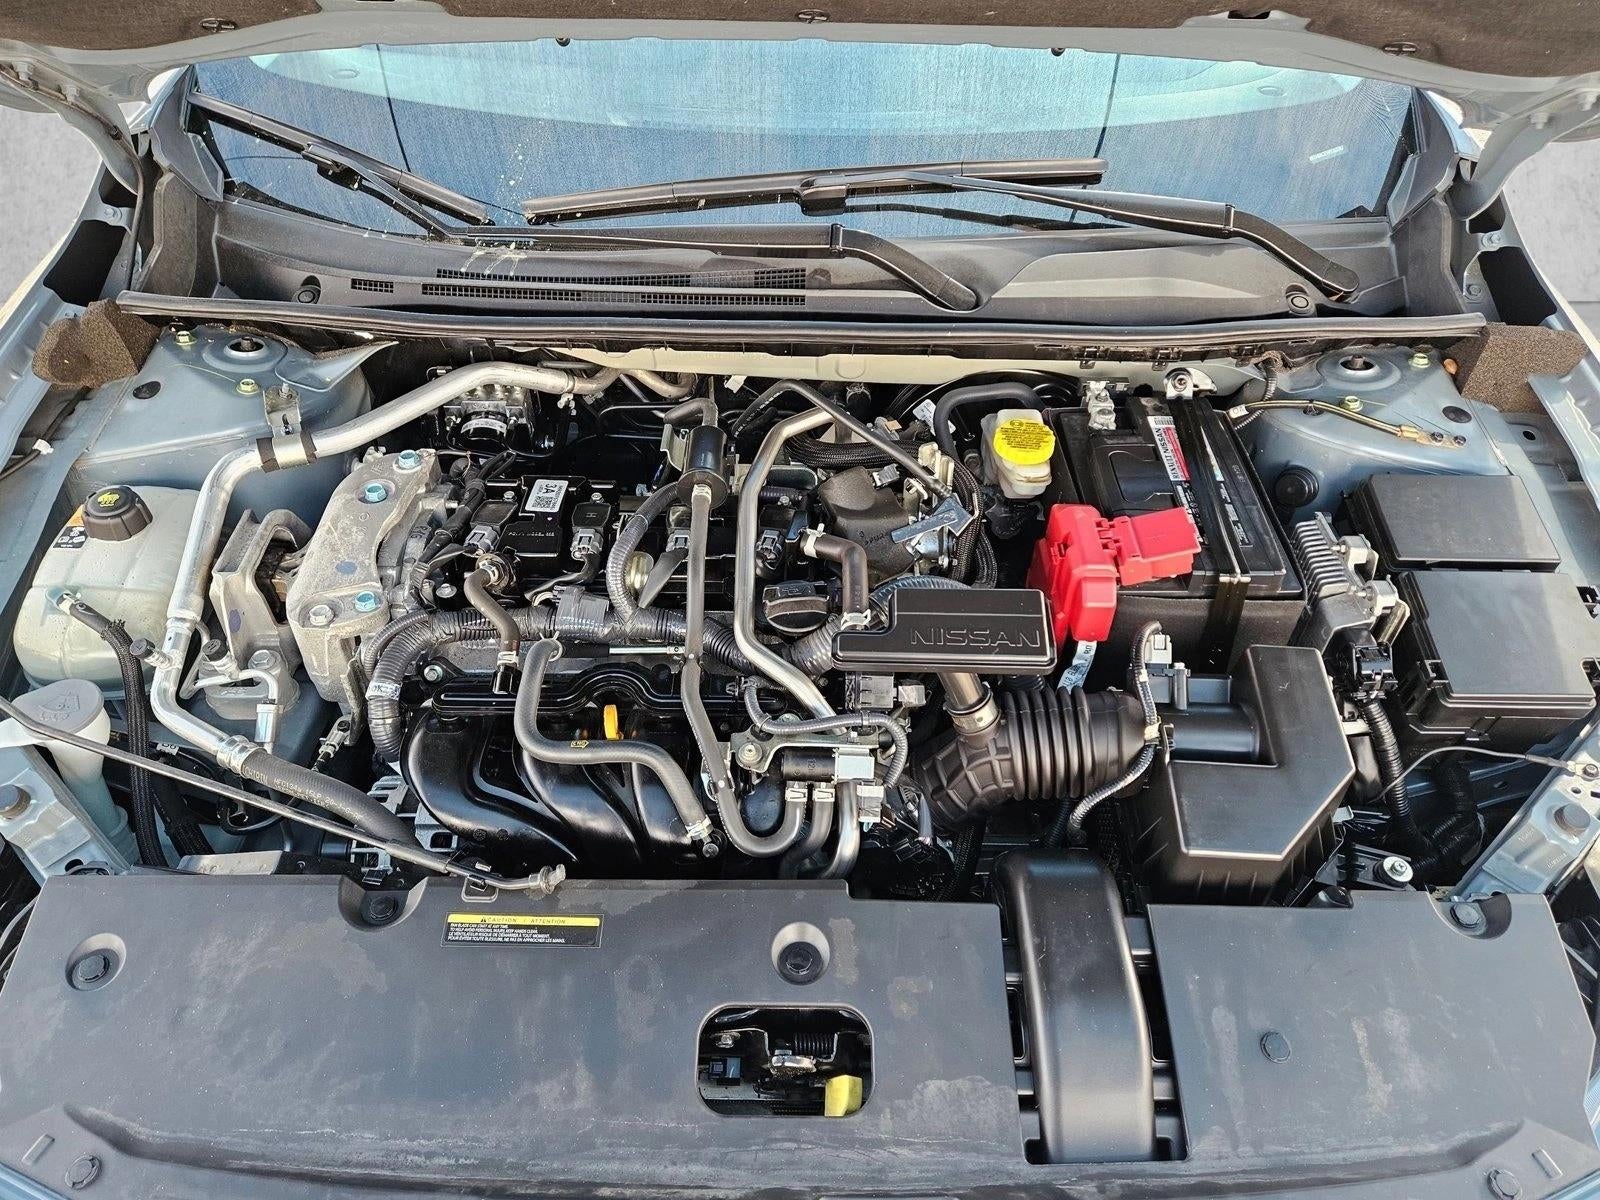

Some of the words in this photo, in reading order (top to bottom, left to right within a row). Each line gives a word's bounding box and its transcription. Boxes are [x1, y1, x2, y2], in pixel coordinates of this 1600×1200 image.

[1154, 427, 1170, 455] NISSAN
[542, 484, 557, 494] 3A
[910, 628, 1040, 648] NISSAN
